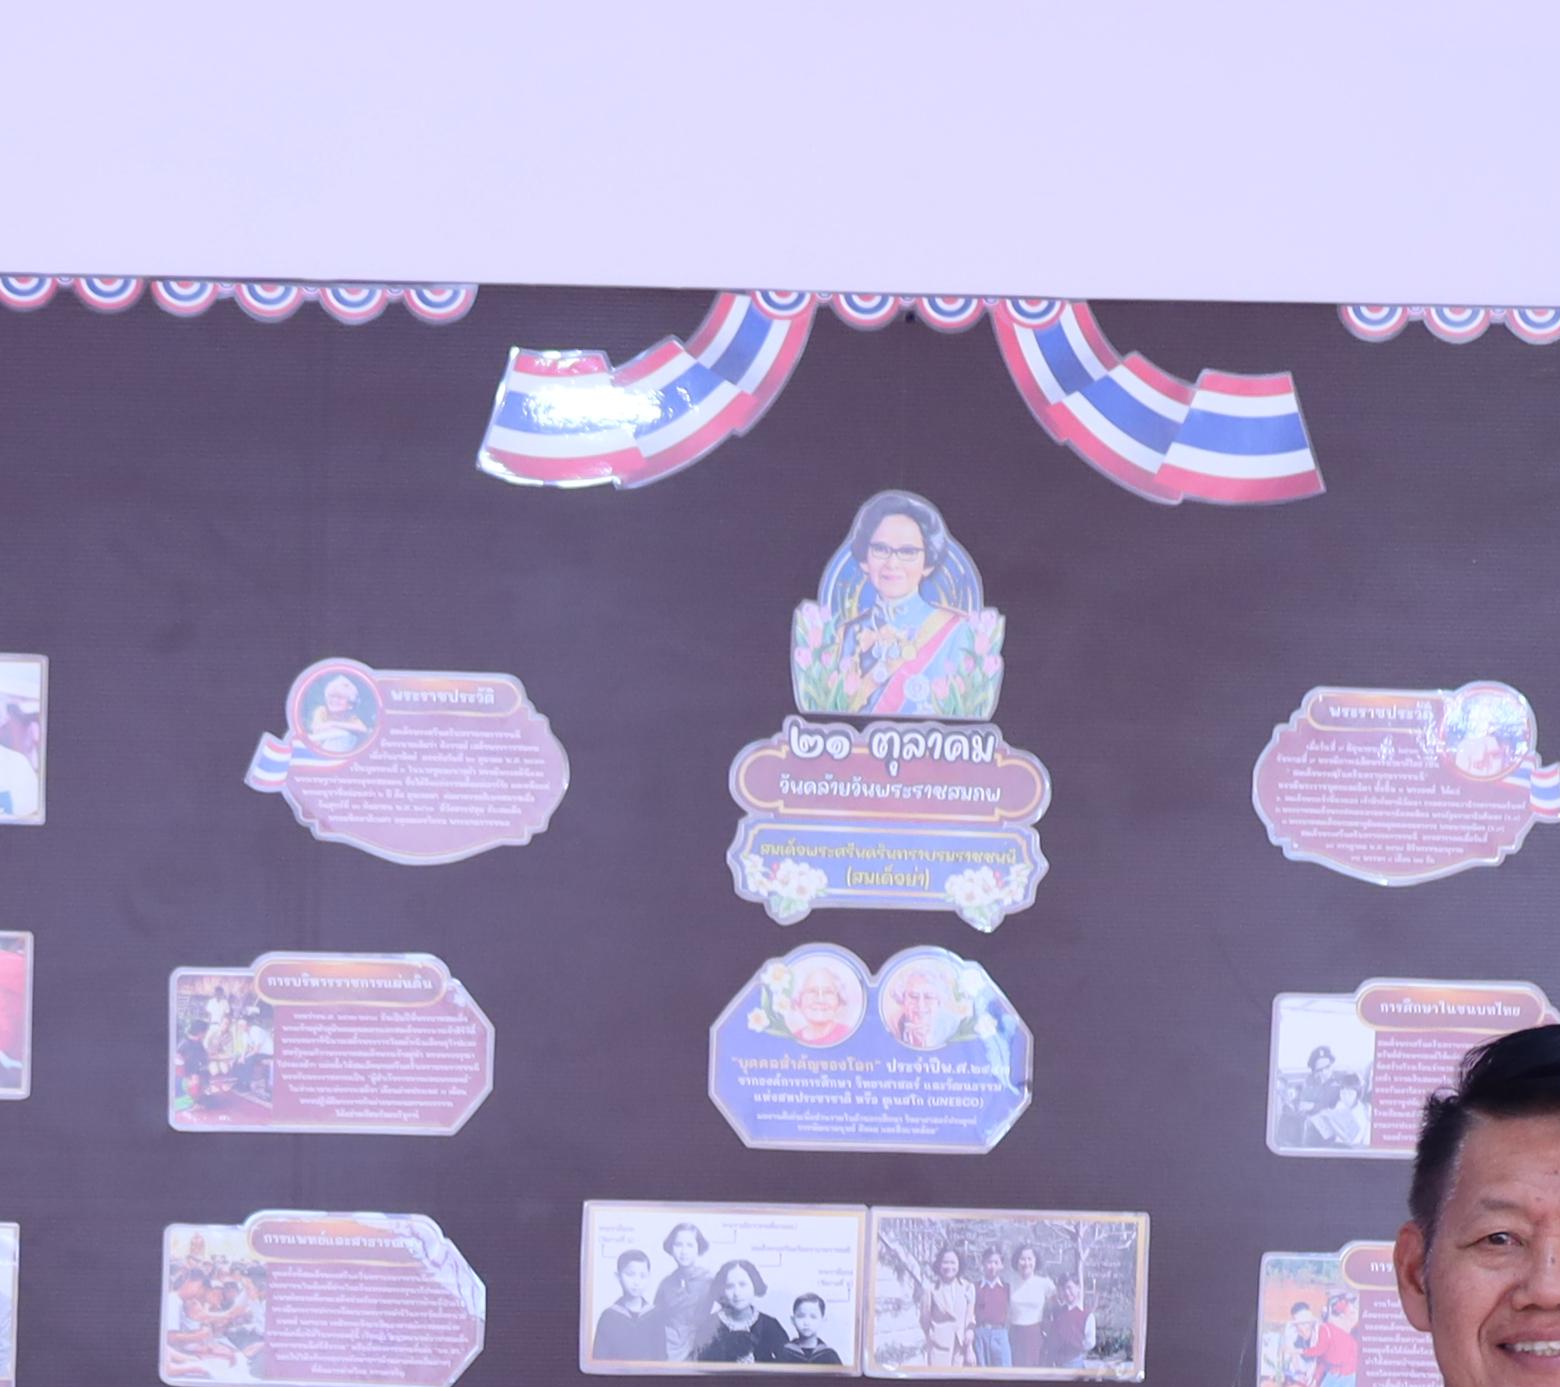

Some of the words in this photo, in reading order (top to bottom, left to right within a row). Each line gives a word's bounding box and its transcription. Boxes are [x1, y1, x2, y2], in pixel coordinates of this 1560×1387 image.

[788, 722, 852, 760] ๒๑
[871, 729, 997, 776] ตุลาคม
[779, 772, 1002, 803] วันคล้ายวันพระราชสมภพ
